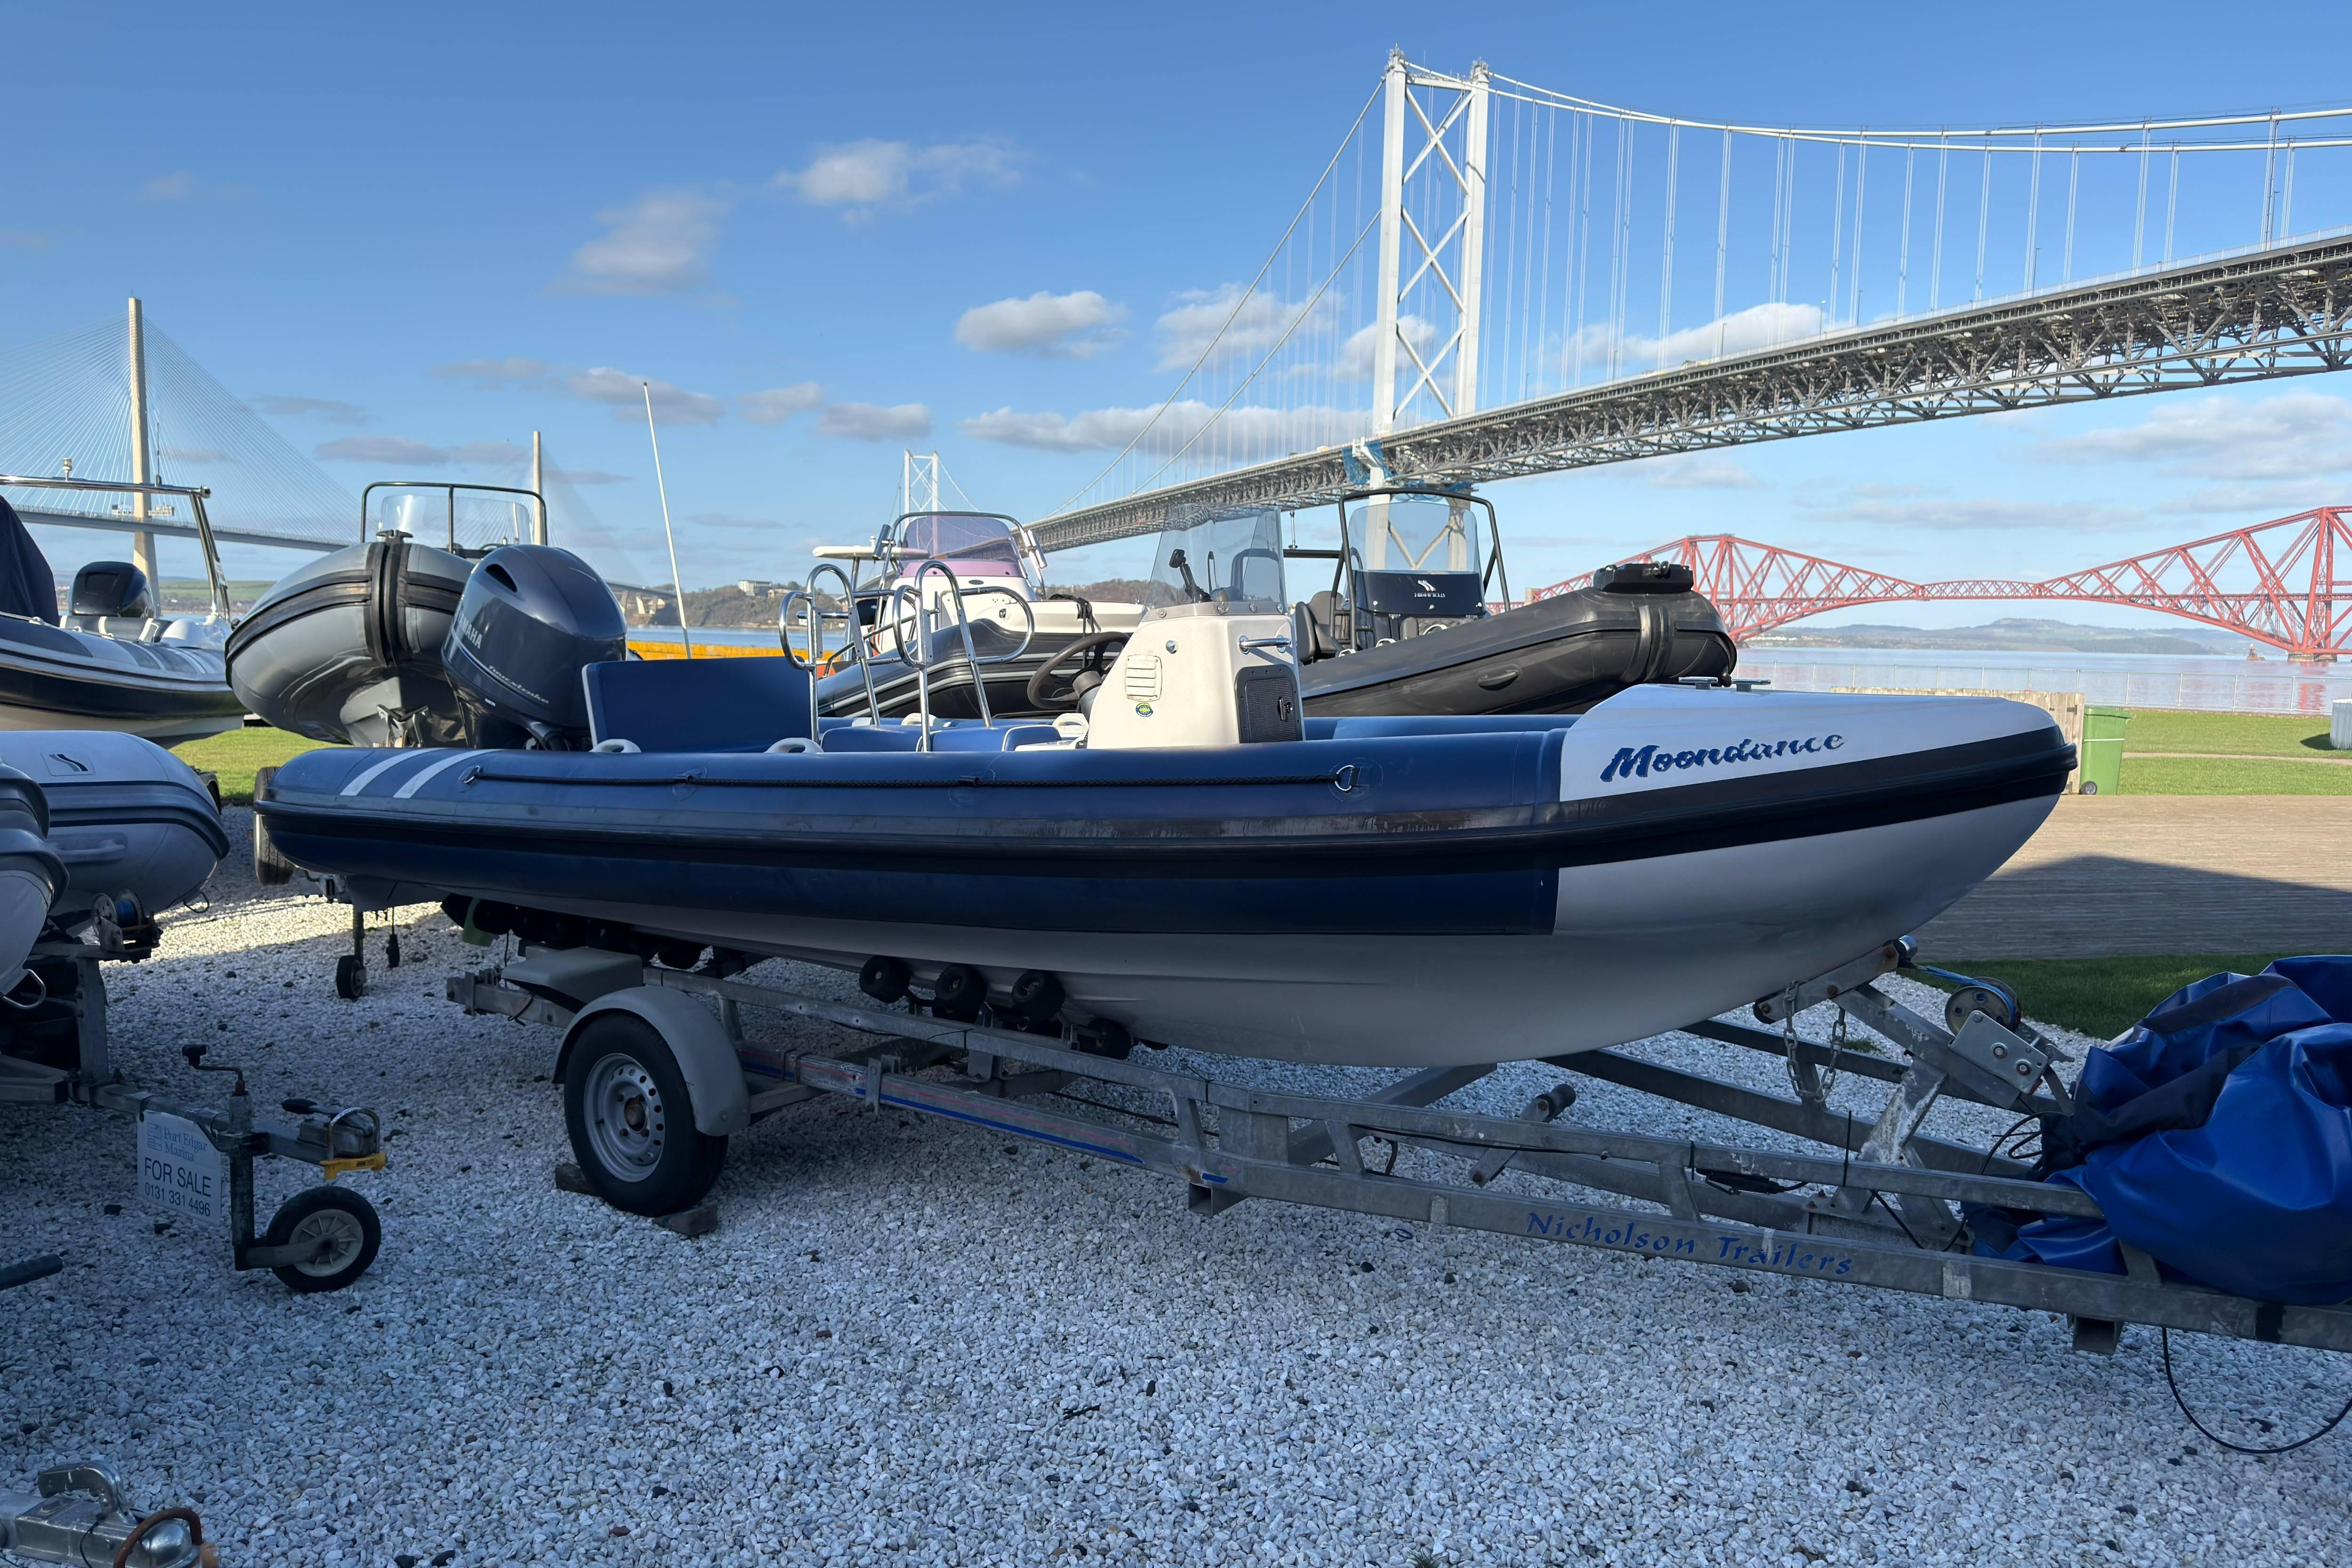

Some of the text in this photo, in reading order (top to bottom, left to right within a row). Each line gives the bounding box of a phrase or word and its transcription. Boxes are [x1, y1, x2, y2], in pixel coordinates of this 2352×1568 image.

[1600, 734, 1845, 782] Moondance
[164, 1127, 207, 1153] Port Edgar
[165, 1141, 194, 1162] Marina
[145, 1157, 211, 1197] FOR SALE
[145, 1182, 211, 1217] 0131 331 4496
[1527, 1211, 1852, 1275] Nicholson Trailers
